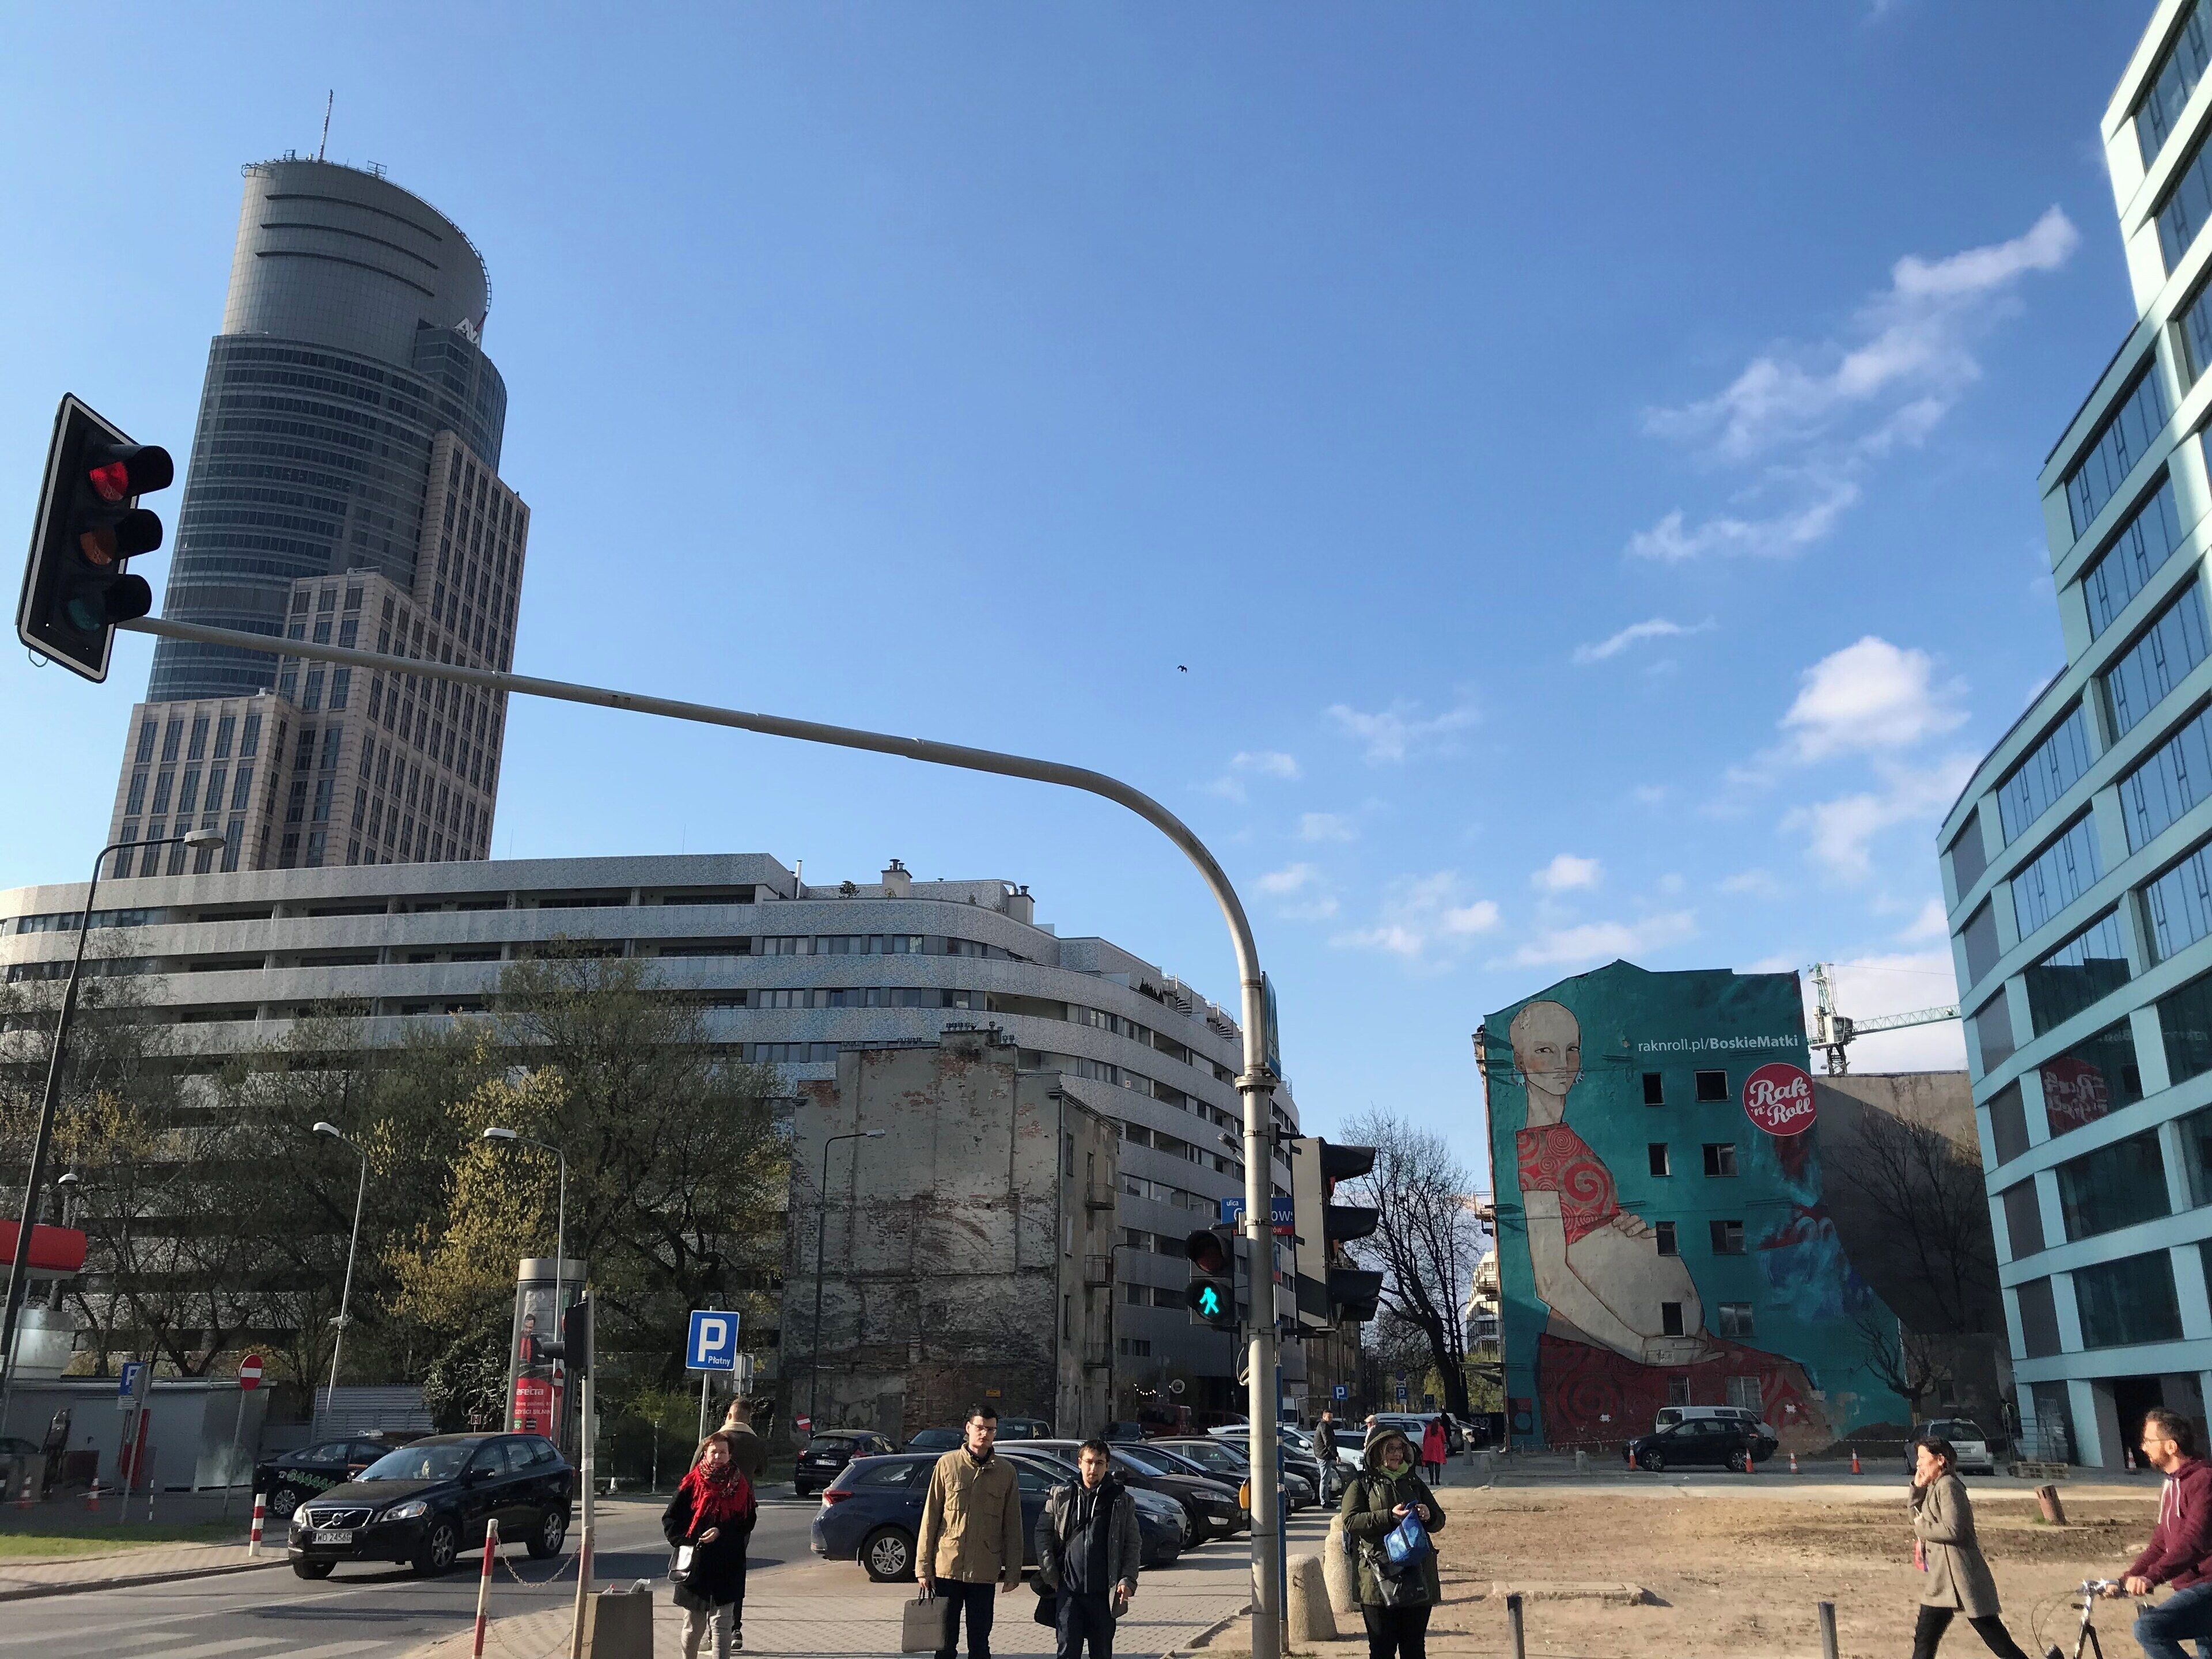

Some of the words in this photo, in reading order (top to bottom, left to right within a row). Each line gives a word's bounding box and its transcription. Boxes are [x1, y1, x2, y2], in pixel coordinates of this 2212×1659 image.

[1638, 1035, 1798, 1052] raknroll.pl/BoskieMatki
[1749, 1076, 1810, 1107] Rak
[1767, 1097, 1813, 1126] Roll
[698, 1318, 727, 1362] P
[708, 1356, 730, 1367] Płatny
[1336, 1387, 1344, 1399] P
